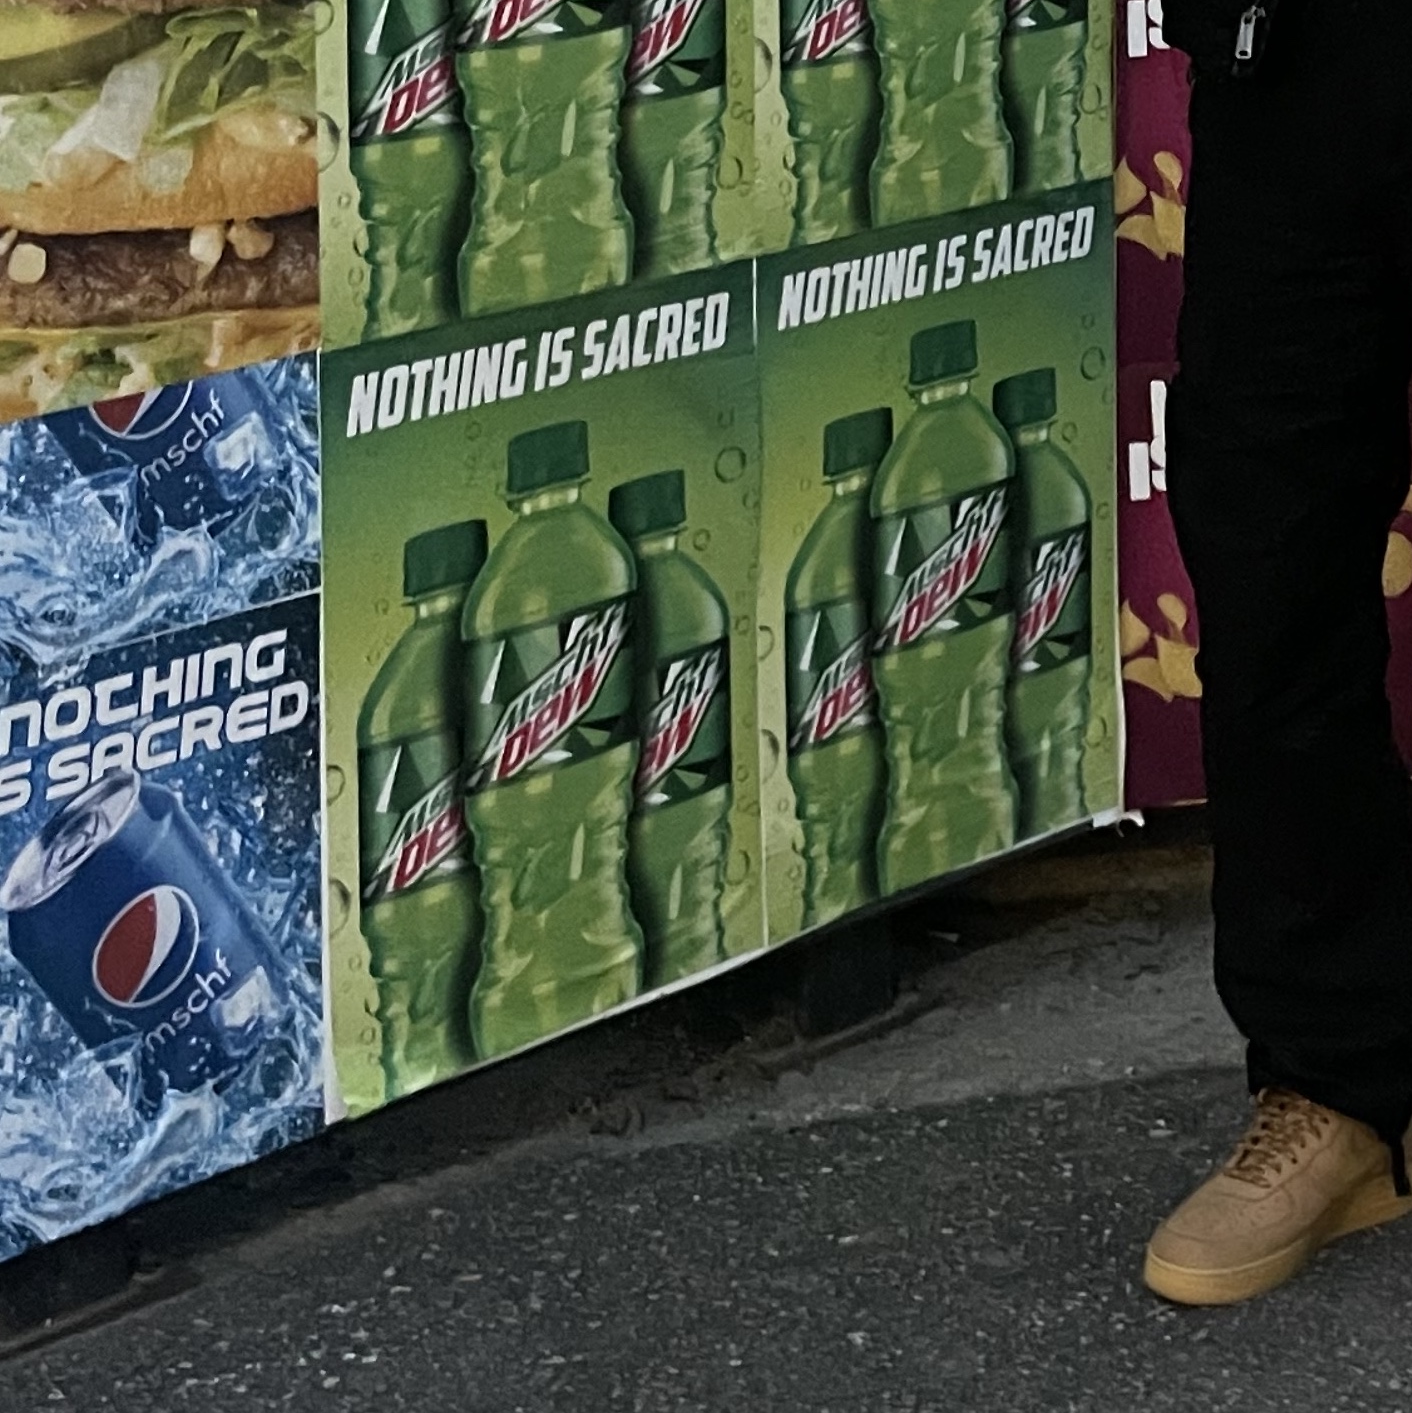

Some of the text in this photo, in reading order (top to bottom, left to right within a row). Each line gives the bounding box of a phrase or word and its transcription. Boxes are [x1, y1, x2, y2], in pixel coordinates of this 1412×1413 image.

[778, 206, 1094, 331] NOTHING IS SACRED
[346, 292, 729, 438] NOTHING IS SACRED
[140, 388, 225, 487] mschf
[0, 628, 287, 757] NOTHING
[46, 680, 309, 801] SACRED
[145, 947, 231, 1053] mschf
